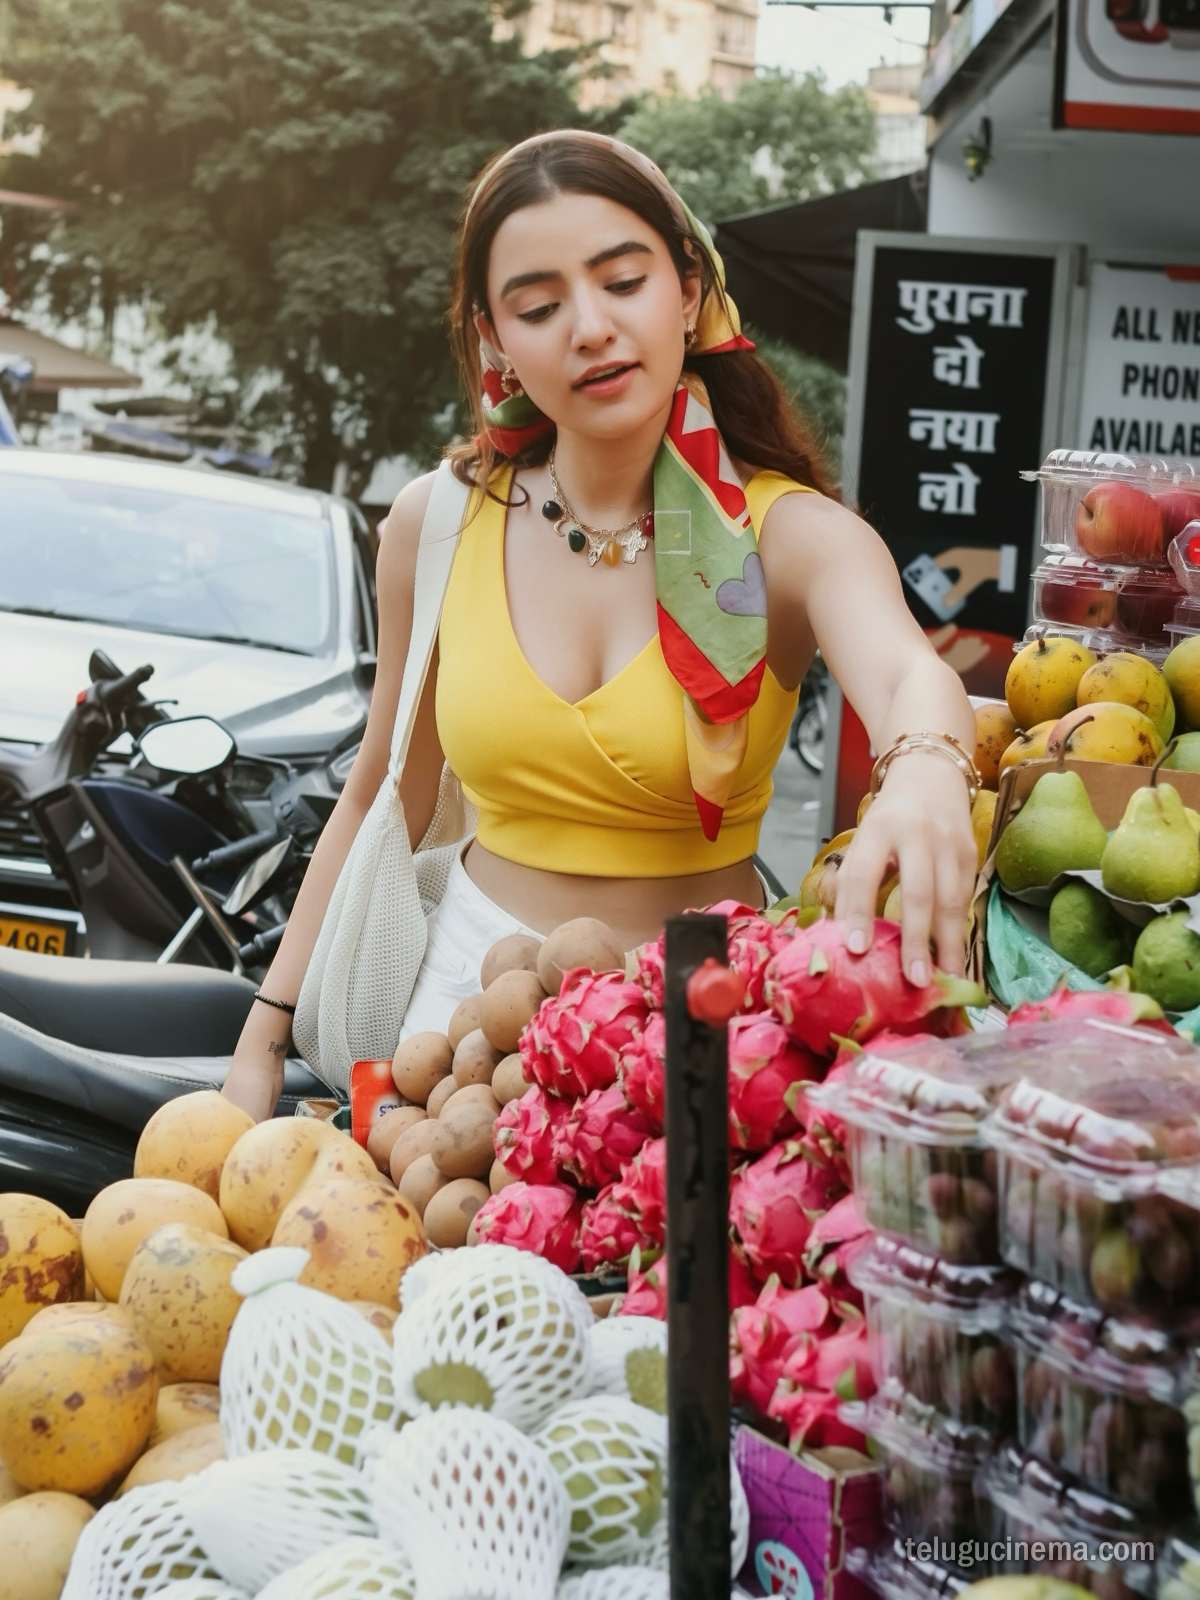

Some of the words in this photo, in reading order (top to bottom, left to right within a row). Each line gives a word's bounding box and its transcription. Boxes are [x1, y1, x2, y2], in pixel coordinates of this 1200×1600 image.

[896, 280, 1028, 334] पुराना
[1111, 306, 1162, 342] ALL
[932, 335, 985, 389] दो
[1122, 363, 1200, 401] PHON
[908, 408, 1001, 454] नया
[918, 462, 981, 515] लो
